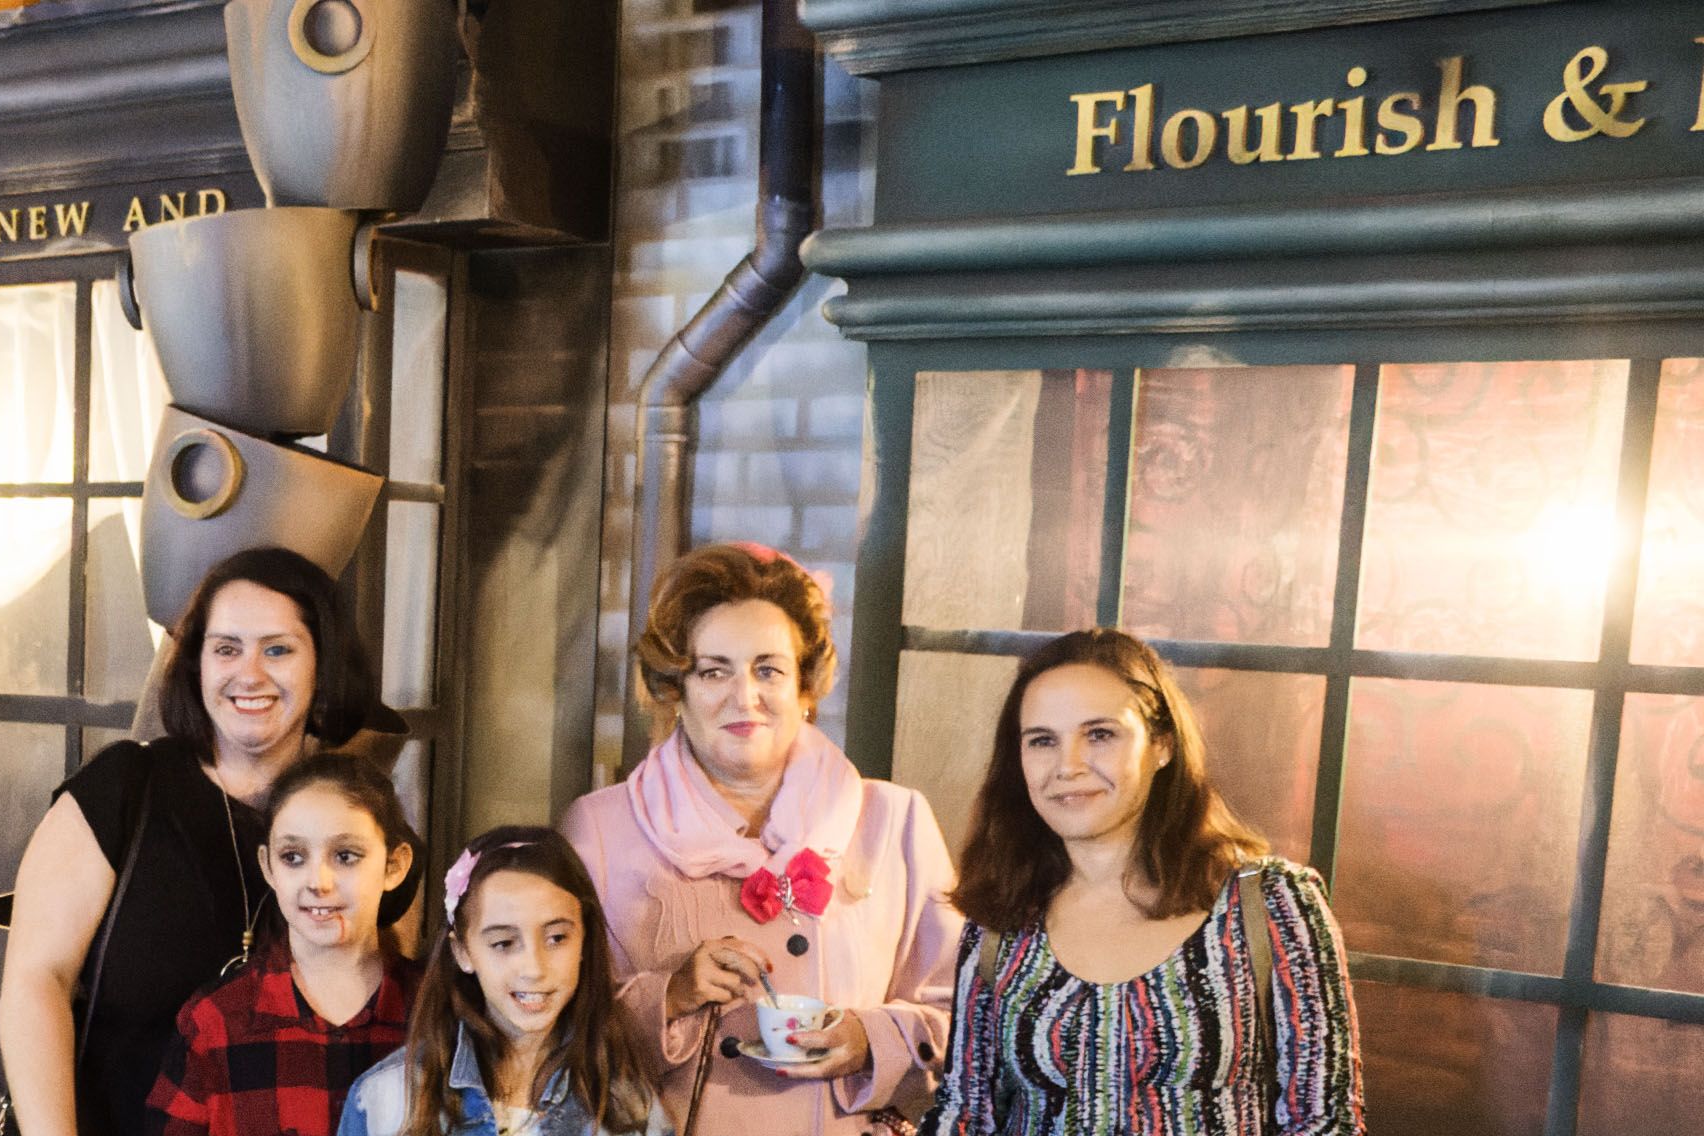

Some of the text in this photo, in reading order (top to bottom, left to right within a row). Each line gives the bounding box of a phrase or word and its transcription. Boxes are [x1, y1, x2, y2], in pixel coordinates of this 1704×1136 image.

[1065, 55, 1500, 176] Flourish
[1542, 45, 1647, 142] &
[122, 188, 227, 232] AND
